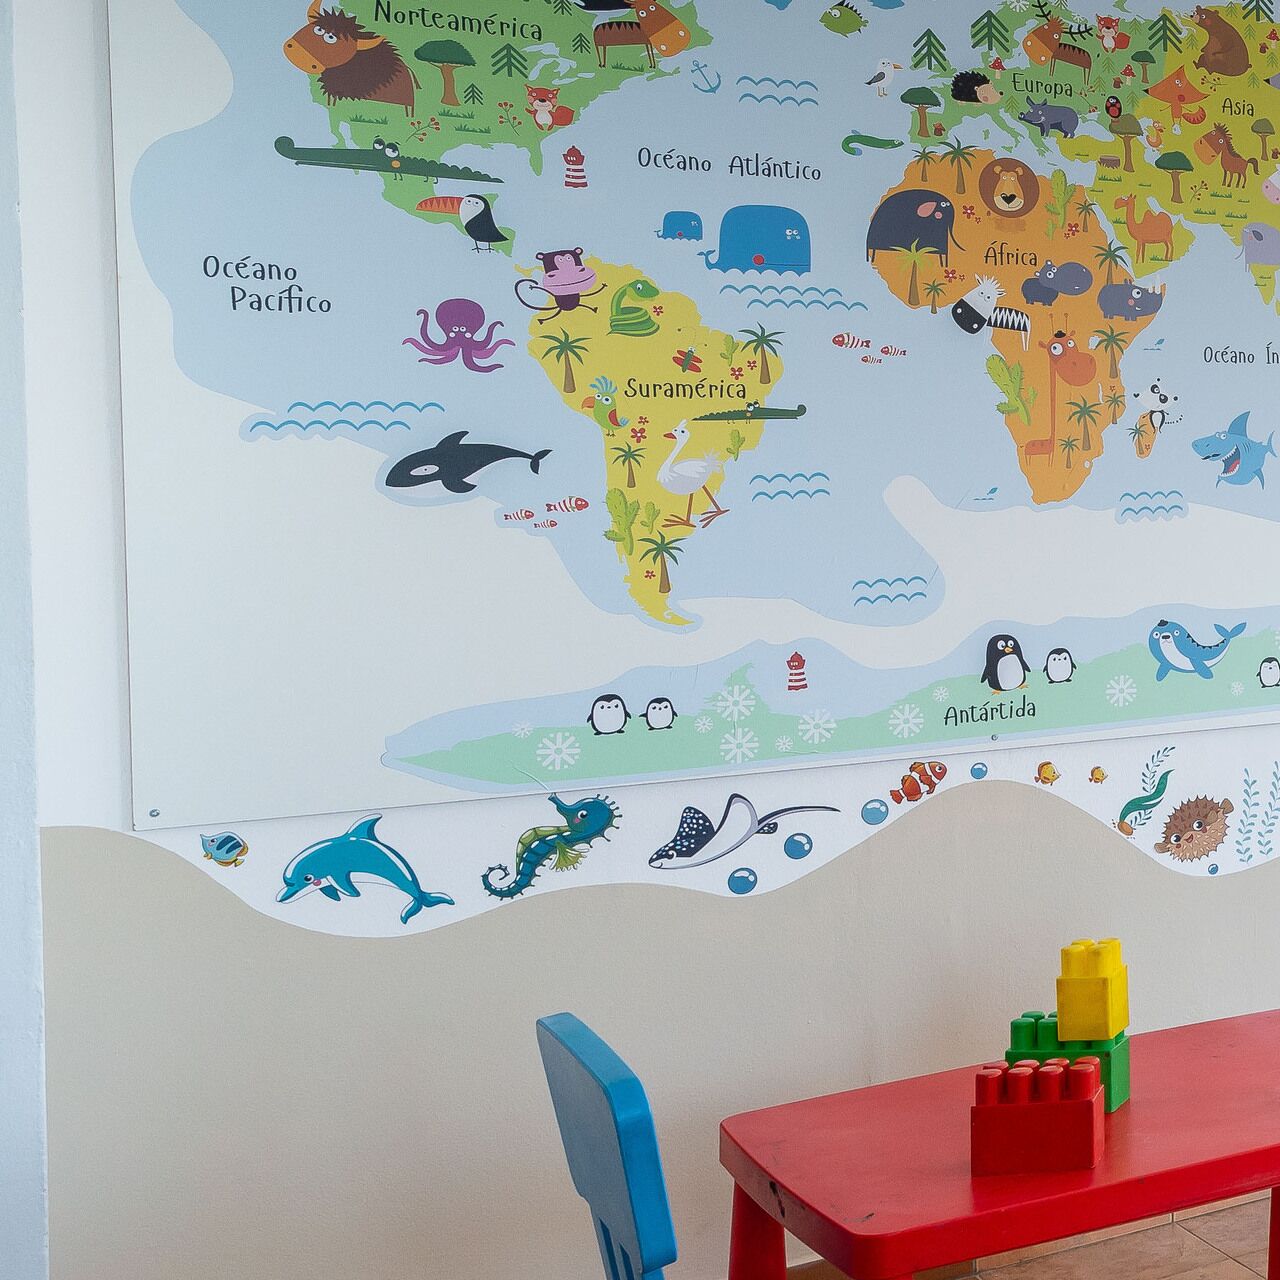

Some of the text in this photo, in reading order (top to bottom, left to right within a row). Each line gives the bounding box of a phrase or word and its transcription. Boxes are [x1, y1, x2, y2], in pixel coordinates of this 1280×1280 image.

[373, 0, 543, 42] Norteamérica
[1012, 72, 1073, 99] Europa
[1221, 97, 1255, 118] Asia
[638, 147, 822, 182] Océano Atlántico
[984, 240, 1039, 268] África
[202, 255, 298, 282] Océano
[230, 284, 332, 314] Pacífico
[1203, 346, 1256, 365] Océano
[624, 377, 747, 400] Suramérica
[943, 698, 1037, 727] Antártida
